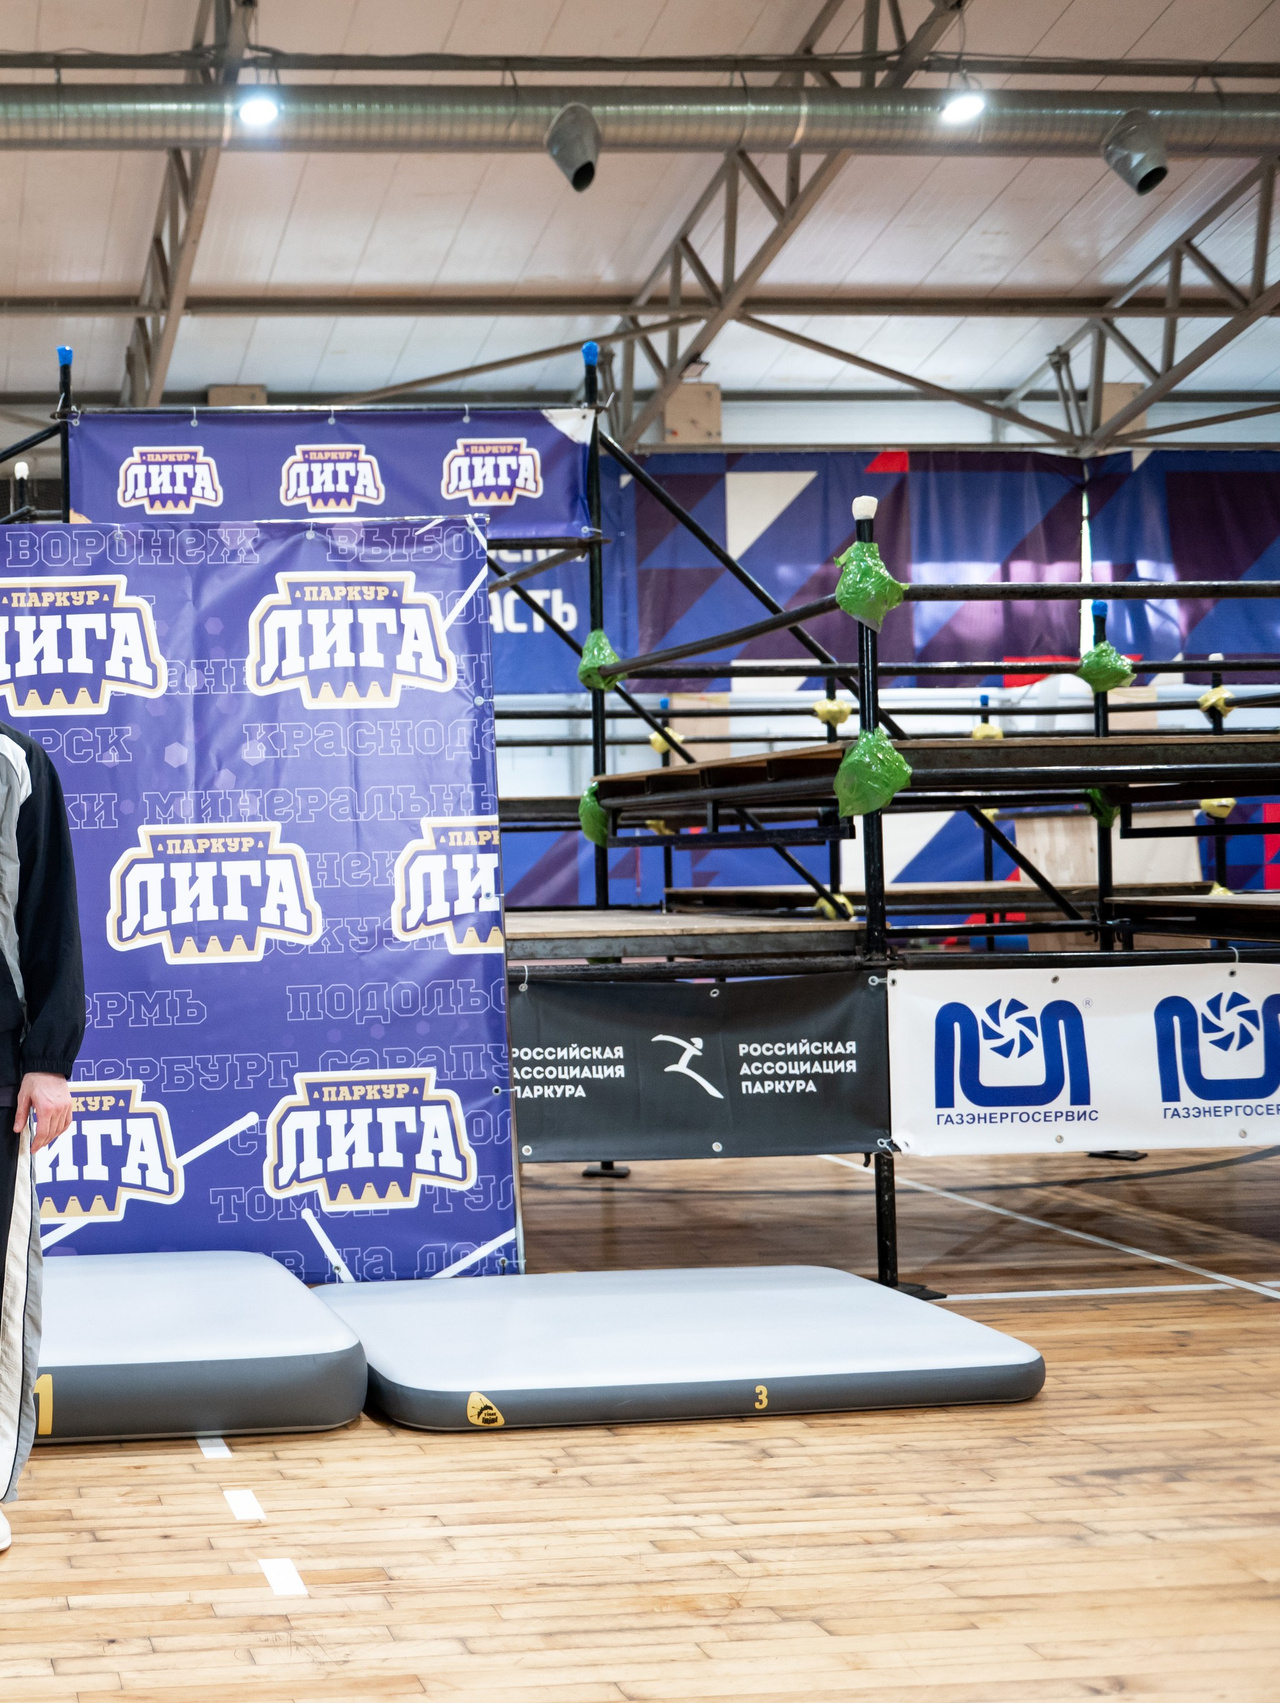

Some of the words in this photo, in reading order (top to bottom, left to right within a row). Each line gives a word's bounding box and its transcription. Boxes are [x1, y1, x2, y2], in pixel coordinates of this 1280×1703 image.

[147, 452, 191, 462] ПАРКУР
[309, 451, 354, 461] ПАРКУР
[469, 444, 513, 455] ПАРКУР
[124, 462, 216, 502] ЛИГА
[285, 461, 380, 500] ЛИГА
[447, 455, 538, 494] ЛИГА
[11, 590, 100, 608] ПАРКУР
[304, 585, 390, 602] ПАРКУР
[261, 607, 444, 684] ЛИГА
[166, 836, 255, 855] ПАРКУР
[122, 858, 309, 940] ЛИГА
[406, 852, 500, 930] ЛИ
[738, 1040, 857, 1057] РОССИЙСКАЯ
[739, 1059, 857, 1077] АССОЦИАЦИЯ
[322, 1083, 410, 1102] ПАРКУР
[741, 1079, 818, 1095] ПАРКУРА
[937, 1109, 1099, 1126] ГАЗЭНЕРГОСЕРВИС
[35, 1117, 170, 1193] ИГА
[278, 1104, 463, 1187] ЛИГА
[34, 1373, 54, 1436] 1
[754, 1384, 769, 1410] 3
